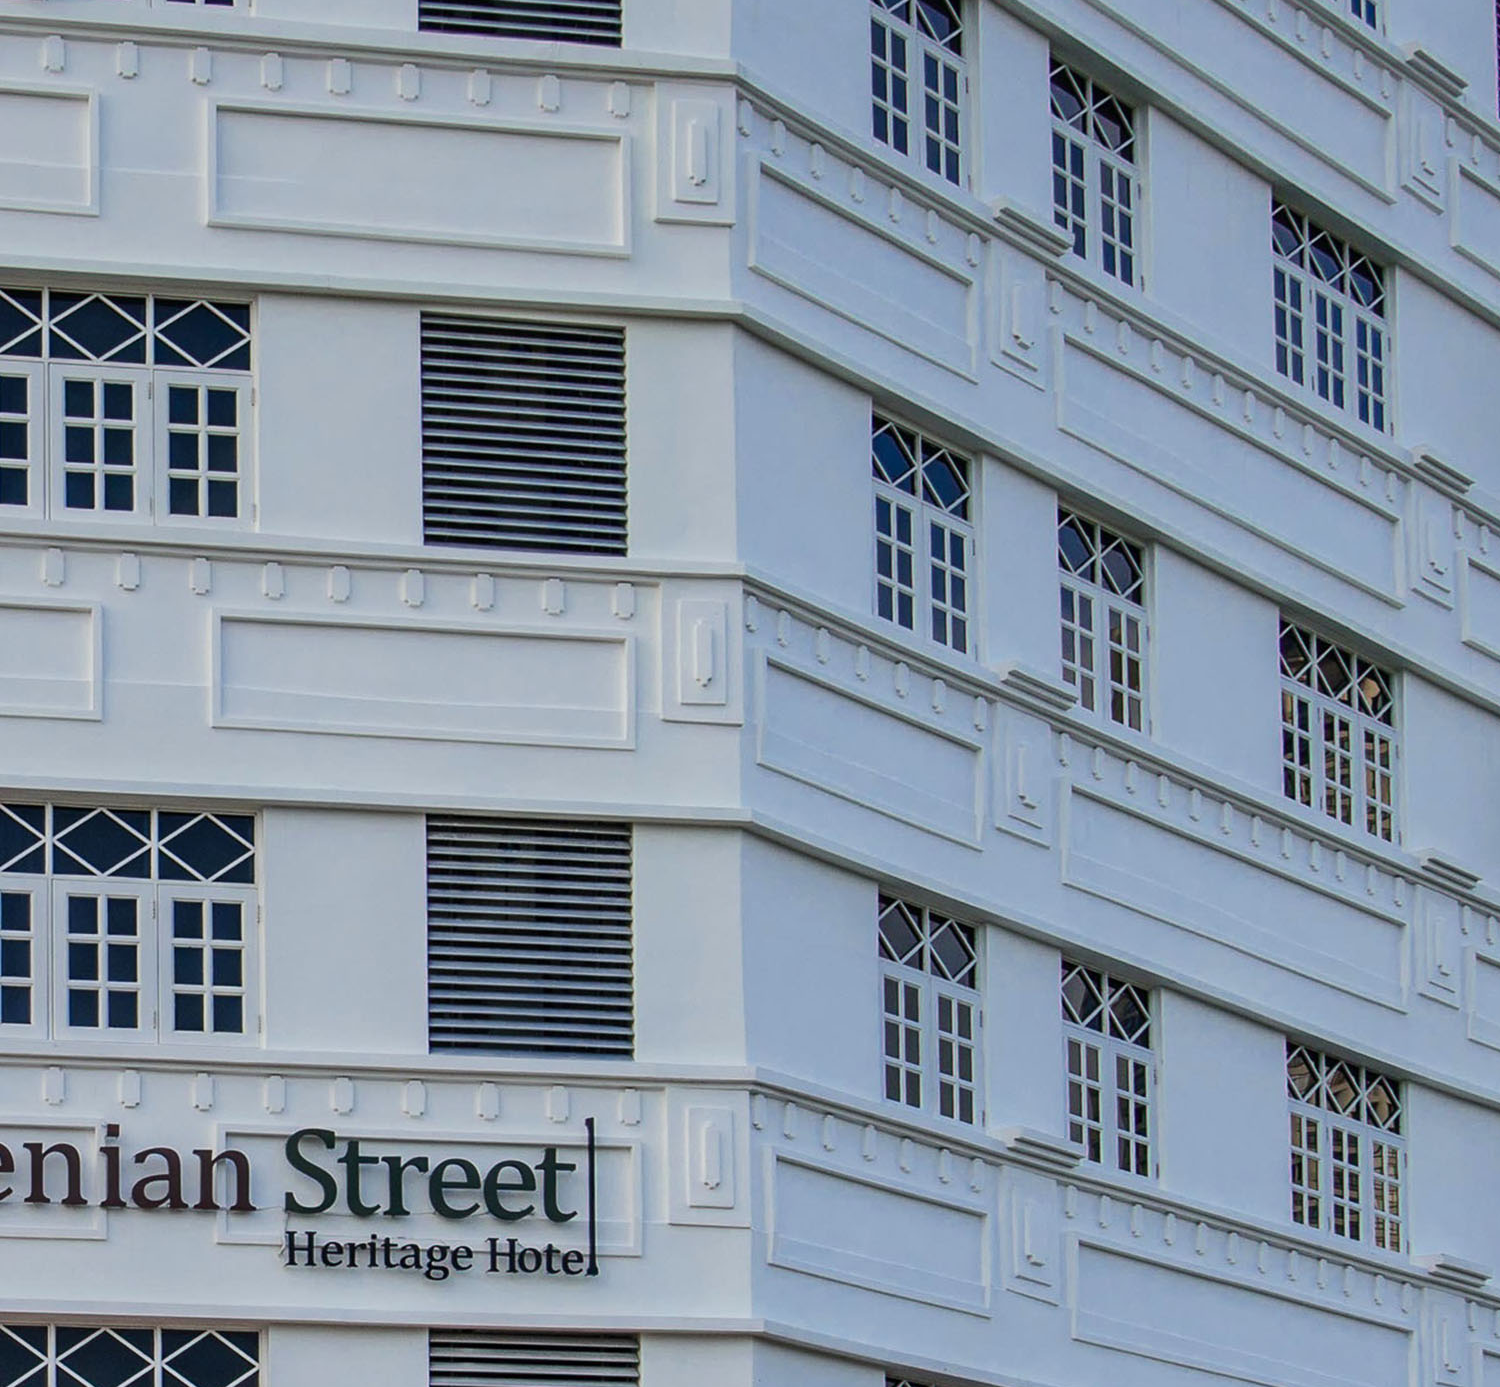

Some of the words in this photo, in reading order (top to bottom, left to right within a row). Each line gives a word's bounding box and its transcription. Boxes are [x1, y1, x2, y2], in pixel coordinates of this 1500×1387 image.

[284, 1127, 580, 1223] Street
[284, 1231, 475, 1281] Heritage
[486, 1236, 599, 1277] Hotel
